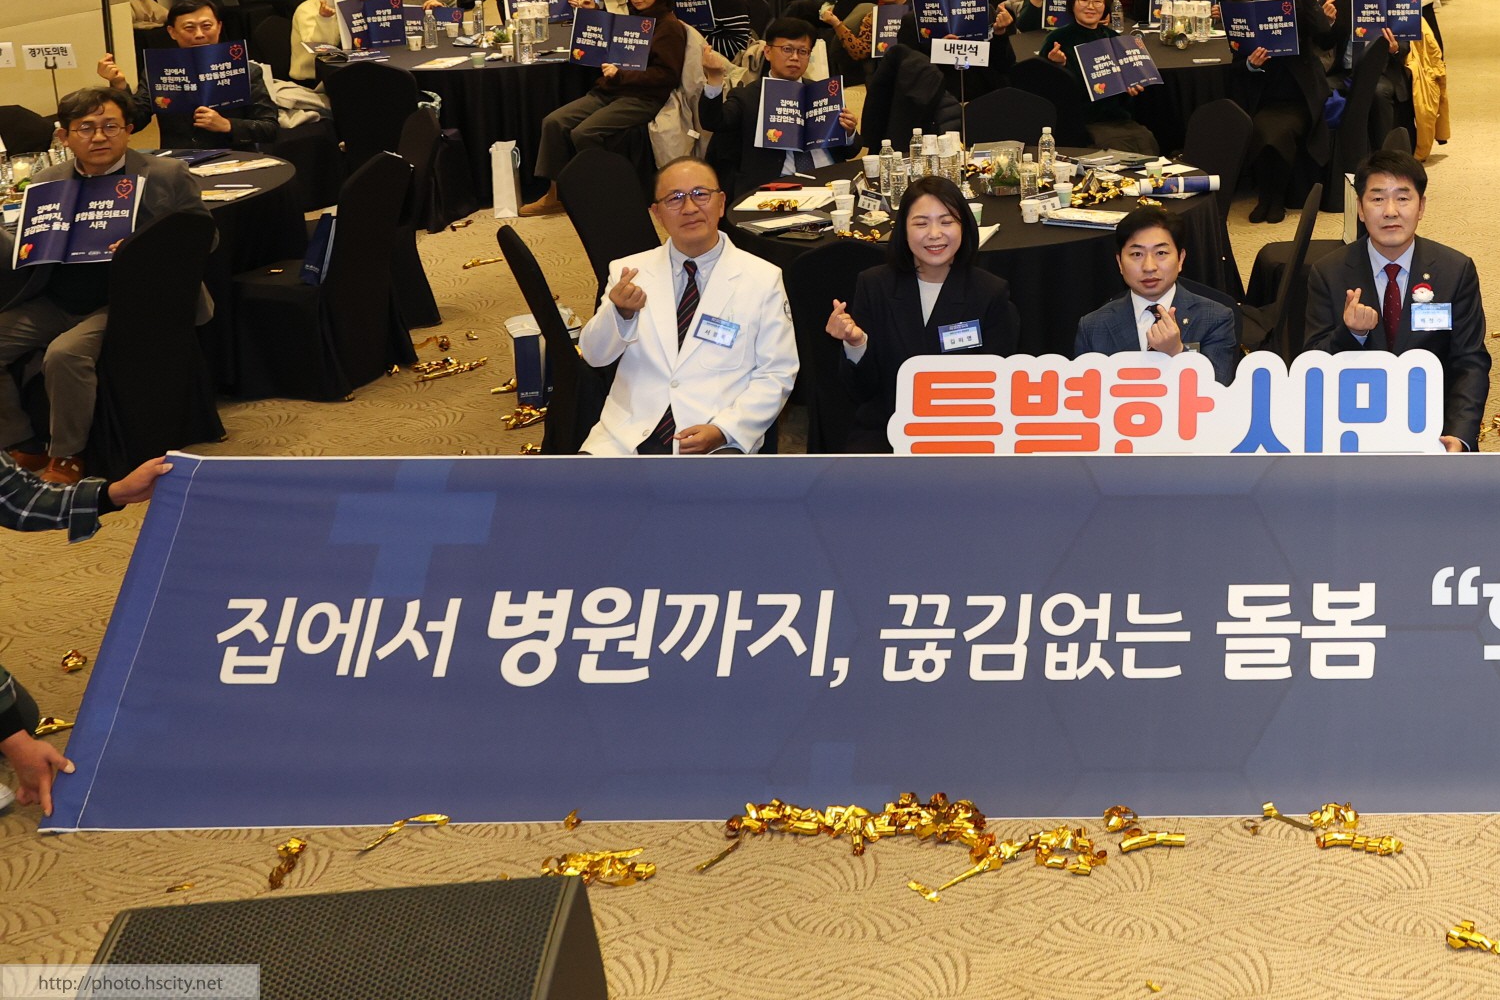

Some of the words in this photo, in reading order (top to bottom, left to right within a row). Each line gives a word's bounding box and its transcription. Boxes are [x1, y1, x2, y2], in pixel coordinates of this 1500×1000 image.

[28, 46, 68, 58] 경기도의원
[943, 43, 979, 57] 내빈석
[217, 78, 230, 86] 시작
[89, 221, 107, 229] 시작
[904, 368, 1215, 454] 특별한
[1230, 367, 1427, 454] 시민
[216, 597, 462, 685] 집에서
[487, 586, 850, 688] 병원까지,
[880, 593, 1191, 682] 끊김없는
[1216, 582, 1386, 680] 돌봄
